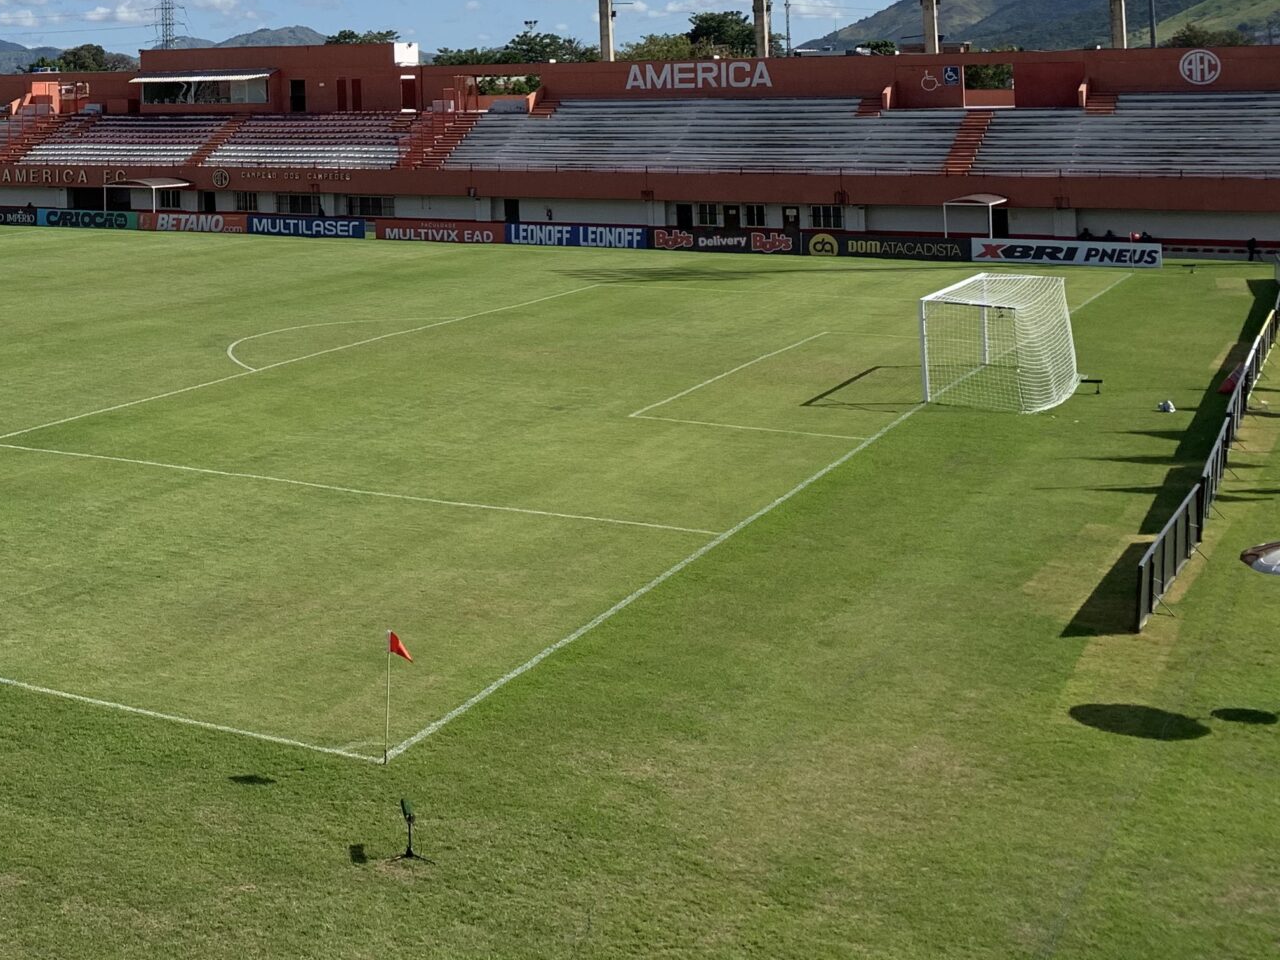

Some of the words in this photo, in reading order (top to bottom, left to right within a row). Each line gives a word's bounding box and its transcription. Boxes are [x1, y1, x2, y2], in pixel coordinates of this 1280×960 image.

[625, 61, 773, 90] AMERICA
[1181, 50, 1219, 83] AFC
[2, 169, 88, 183] AMERICA
[253, 218, 359, 235] MULTILASER
[385, 228, 458, 242] MULTIVIX
[464, 230, 493, 243] EAD
[511, 224, 571, 245] LEONOFF
[580, 226, 642, 248] LEONOFF
[655, 230, 694, 249] Bob's
[698, 236, 747, 247] Delivery
[751, 232, 792, 253] Bob's
[848, 240, 961, 256] DOMATACADISTA
[976, 243, 1079, 262] XBRI
[1084, 247, 1160, 265] PNEUS
